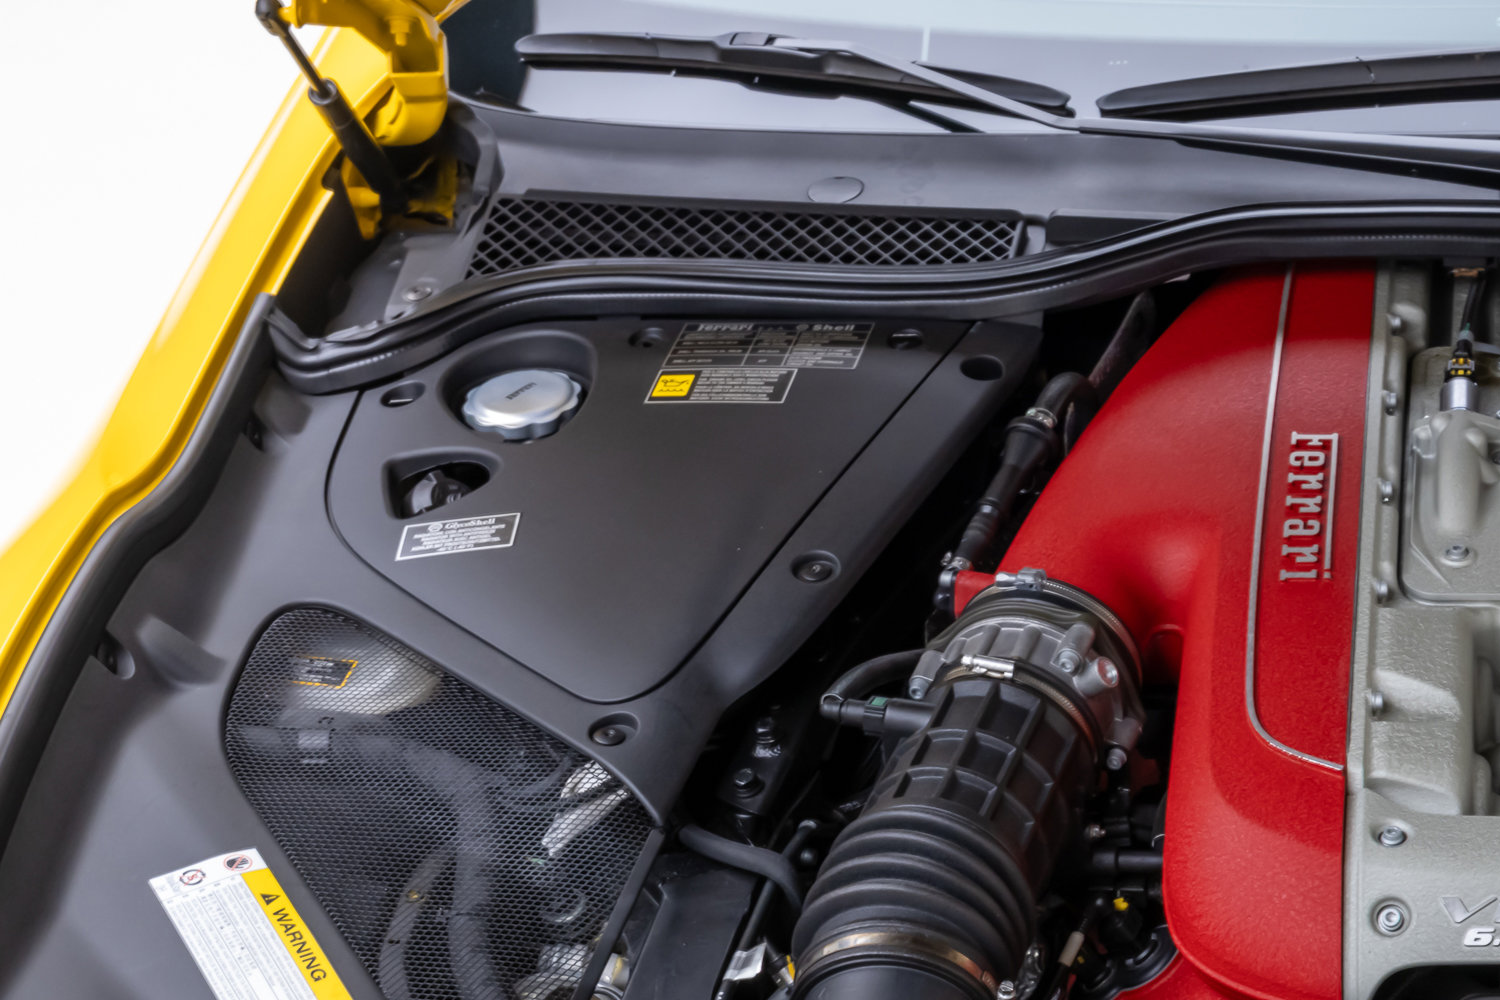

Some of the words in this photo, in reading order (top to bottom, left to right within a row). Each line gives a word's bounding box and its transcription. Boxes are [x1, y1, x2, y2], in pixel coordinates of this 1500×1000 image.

[812, 324, 854, 332] Shell
[1279, 431, 1339, 582] Ferrari
[272, 907, 327, 983] WARNING
